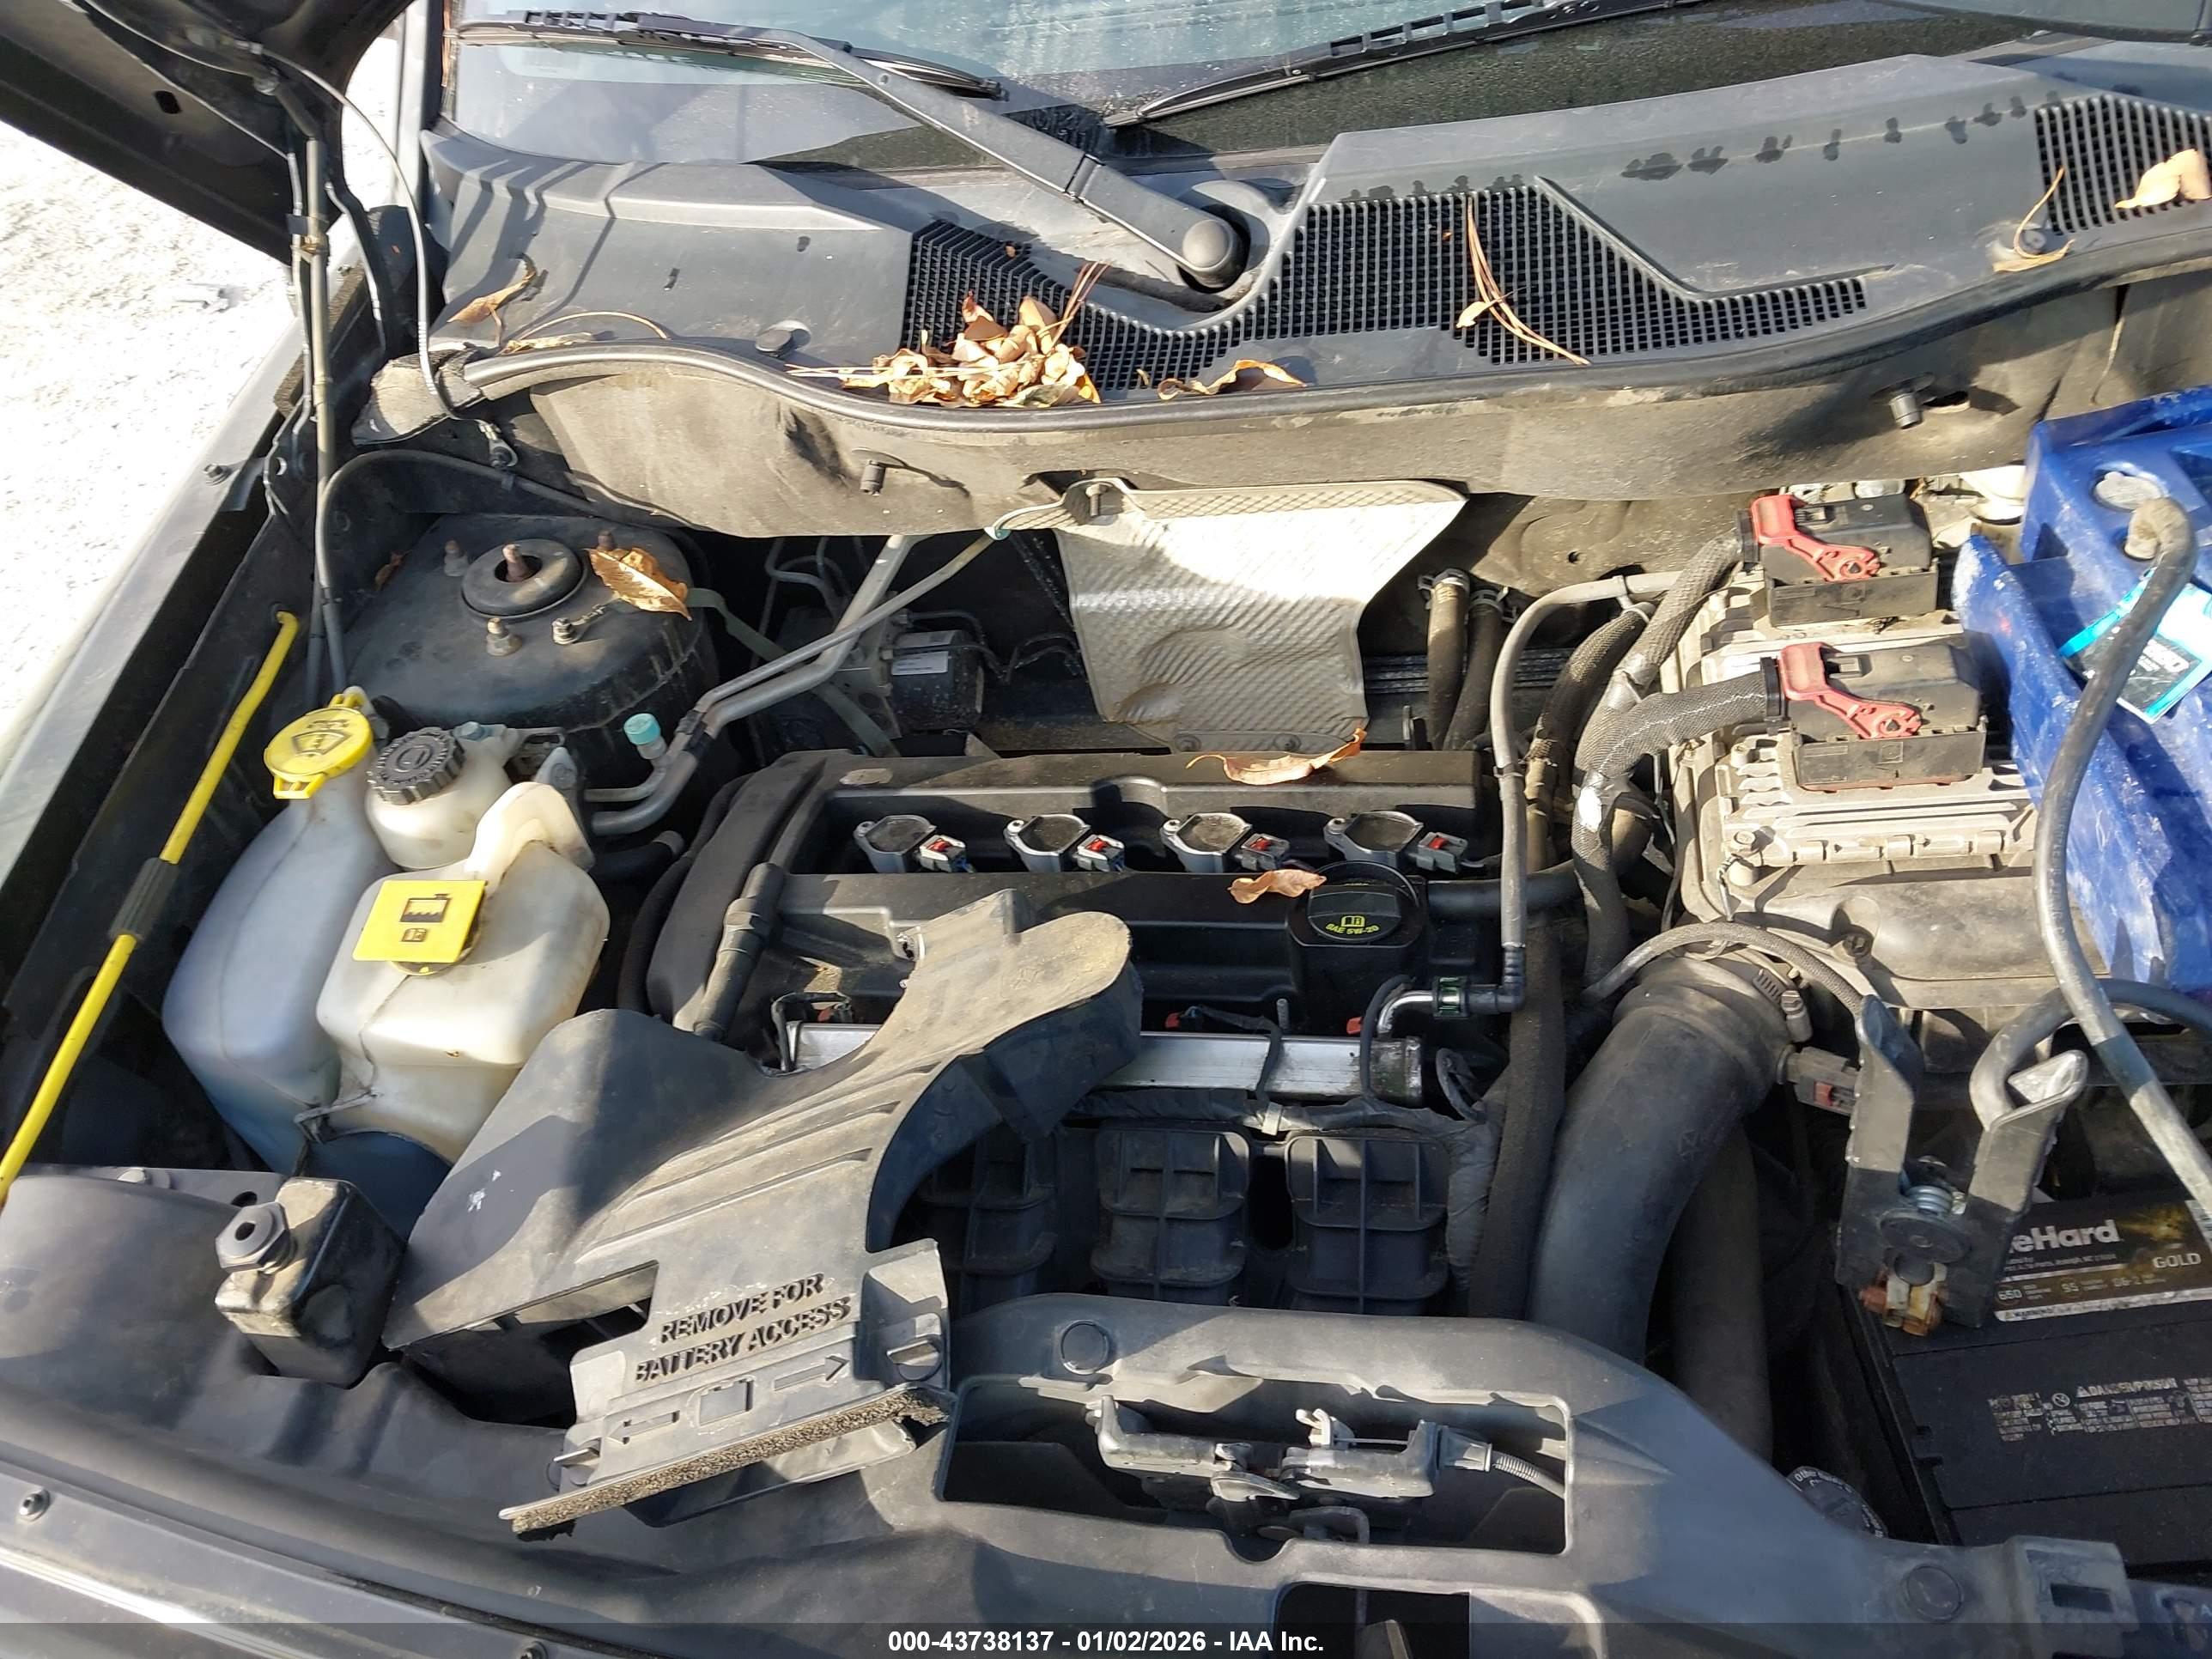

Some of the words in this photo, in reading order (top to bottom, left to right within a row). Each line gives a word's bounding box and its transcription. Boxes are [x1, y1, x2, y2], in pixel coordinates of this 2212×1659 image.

[1325, 923, 1346, 934] SAE
[1346, 925, 1380, 935] 5W-20
[2008, 1219, 2120, 1254] eHard
[2153, 1253, 2202, 1268] GOLD
[1997, 1289, 2022, 1300] 650
[660, 1291, 769, 1343] REMOVE
[773, 1273, 824, 1309] FOR
[635, 1331, 744, 1381] BATTERY
[748, 1296, 851, 1351] ACCESS
